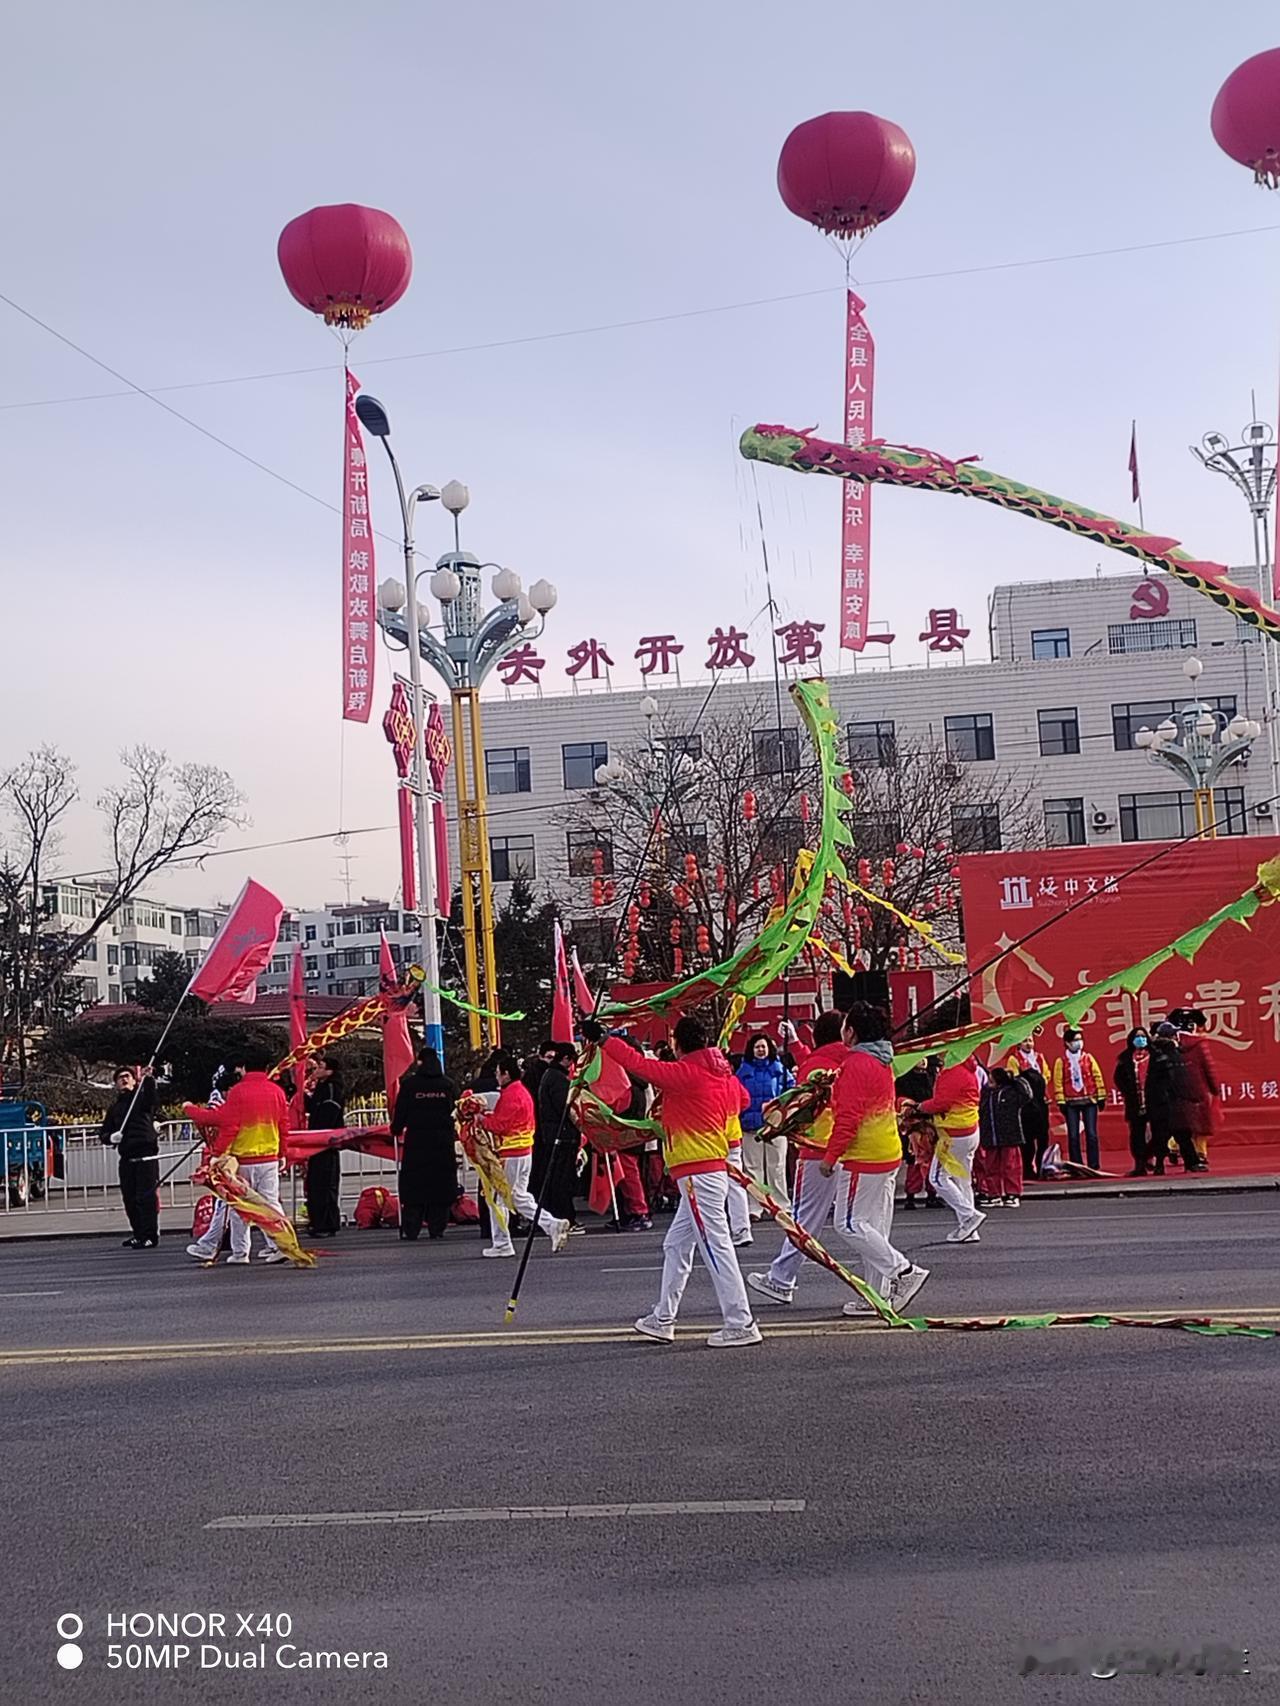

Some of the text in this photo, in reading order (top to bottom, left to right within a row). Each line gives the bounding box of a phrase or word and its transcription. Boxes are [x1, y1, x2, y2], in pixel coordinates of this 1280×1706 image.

[496, 608, 972, 686] 关外开放第一县
[416, 1091, 447, 1099] CHINA
